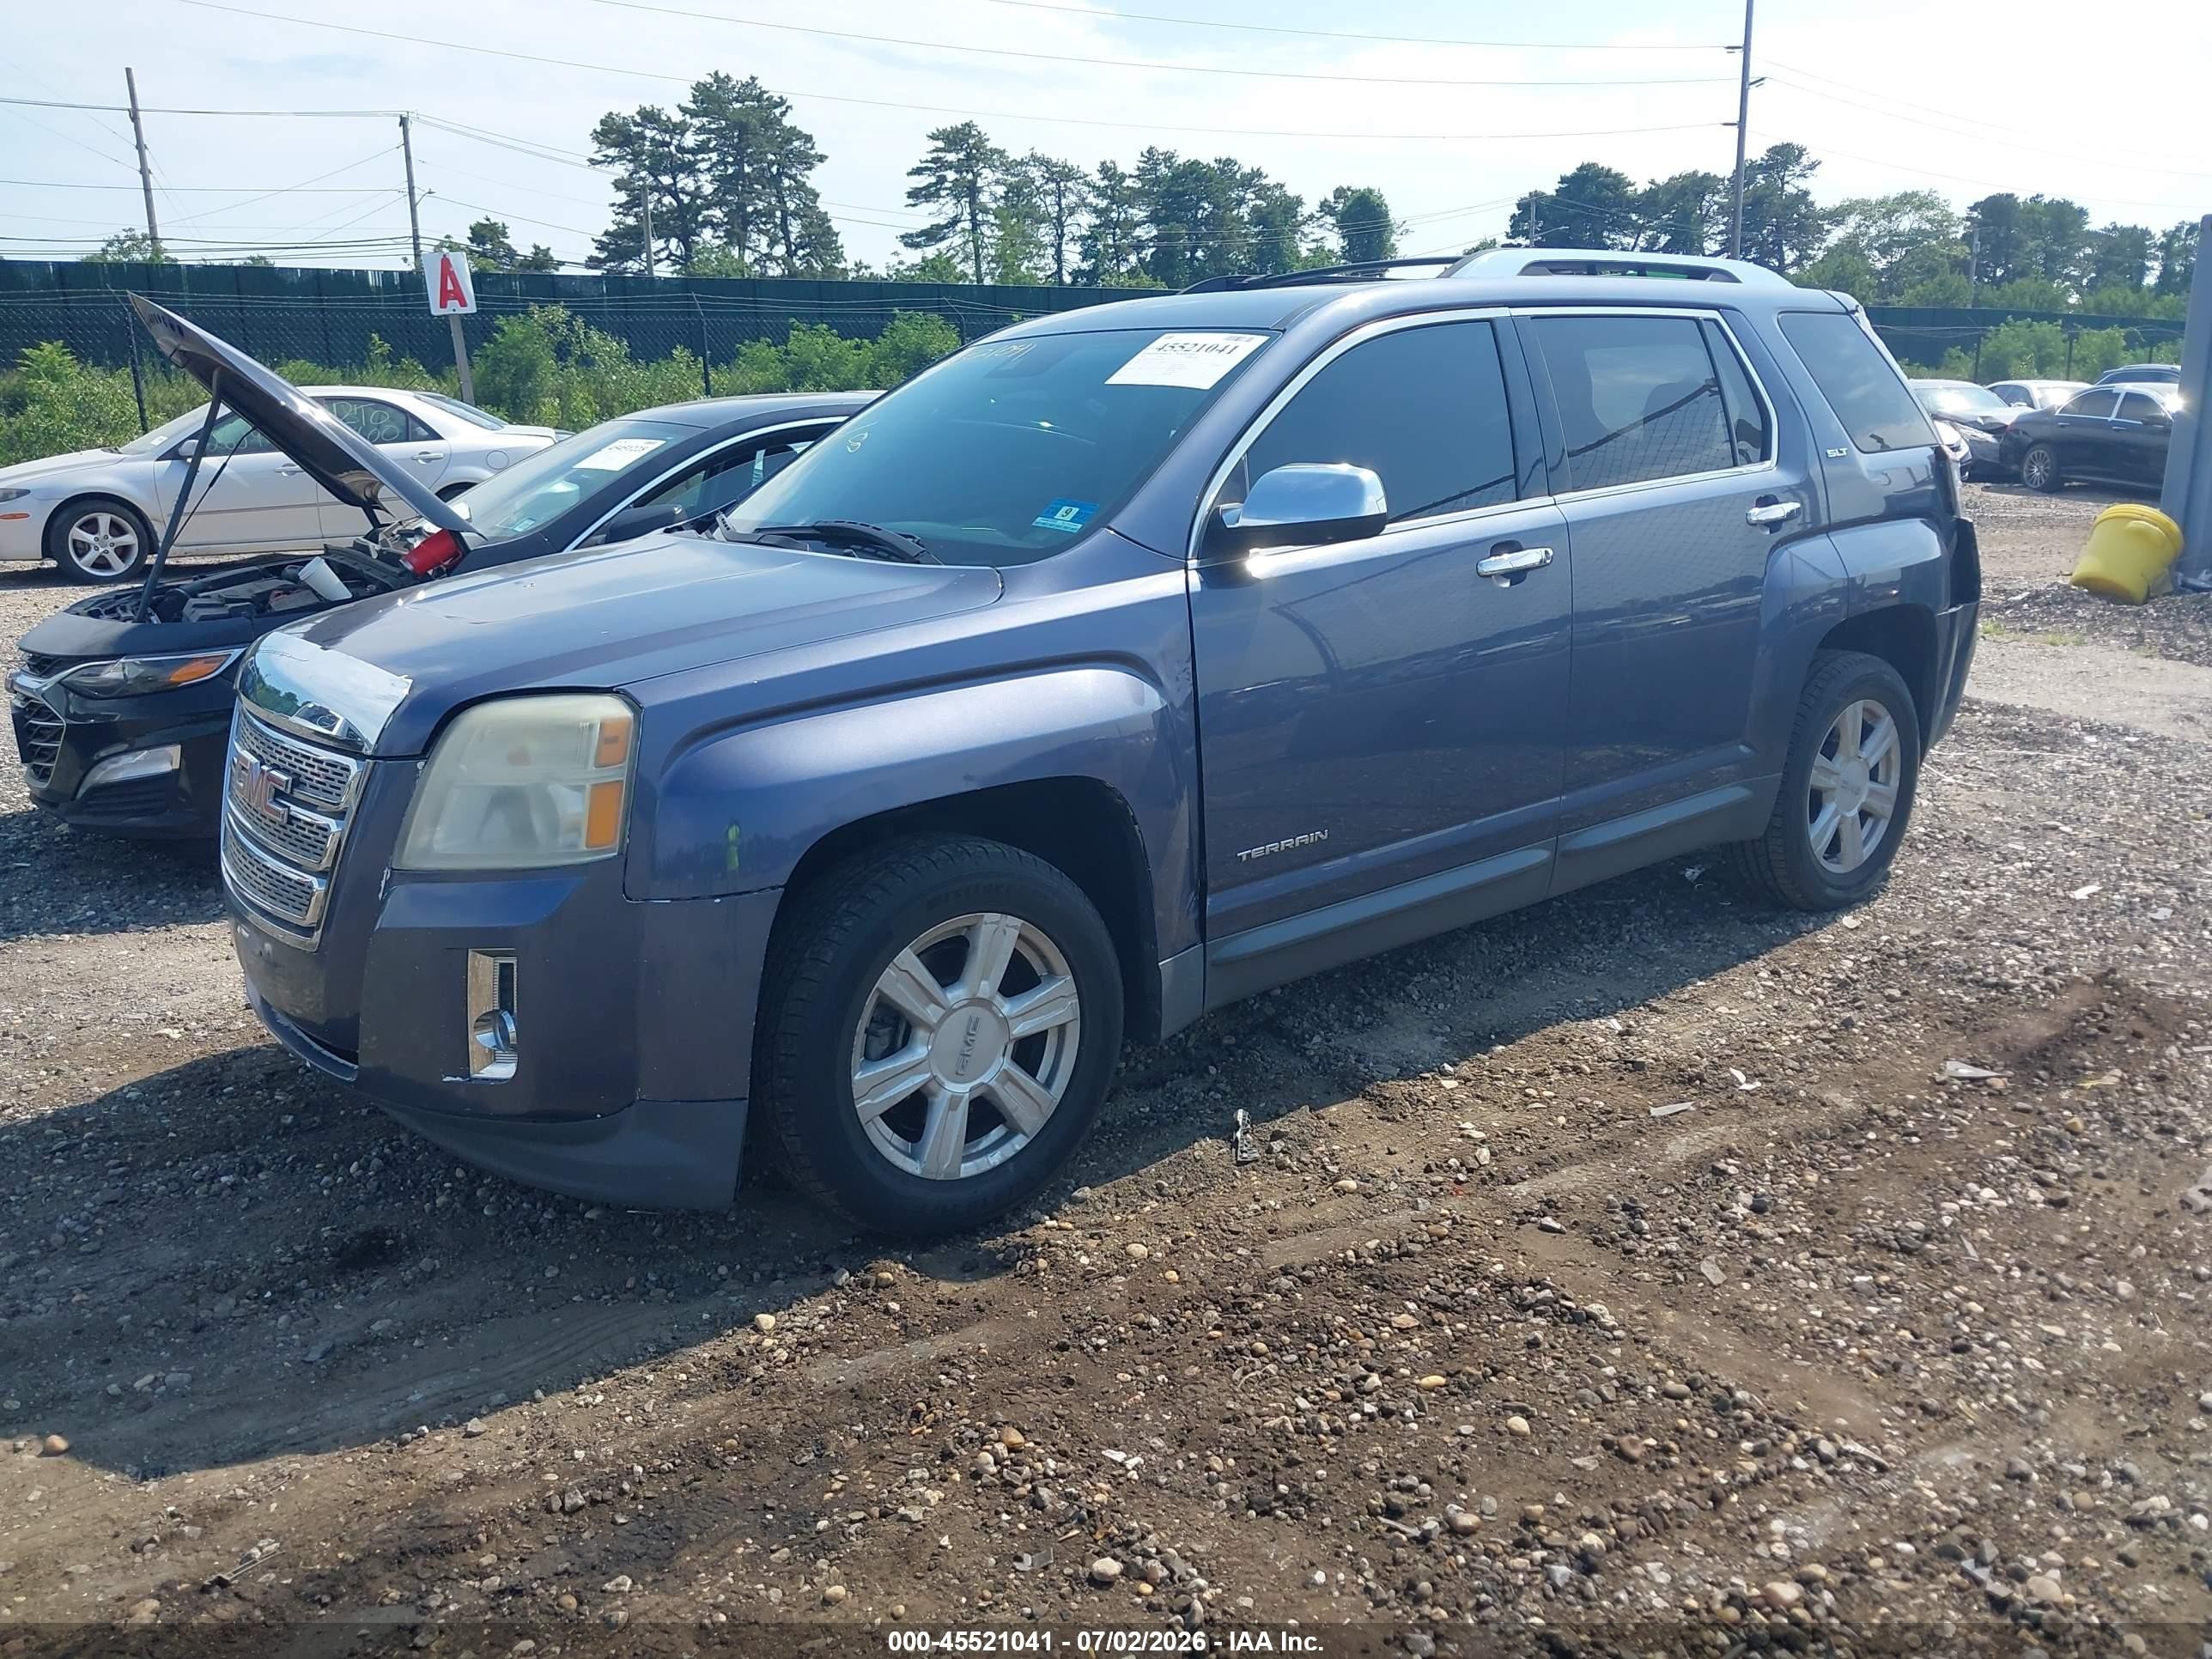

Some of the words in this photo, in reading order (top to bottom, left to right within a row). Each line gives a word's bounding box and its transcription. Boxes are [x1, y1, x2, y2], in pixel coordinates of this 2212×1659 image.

[439, 255, 468, 308] A
[1155, 343, 1239, 355] 45521041
[1826, 447, 1848, 458] SLT
[235, 750, 292, 824] GMC
[1237, 829, 1328, 862] TERRAIN
[954, 1014, 981, 1077] GMC
